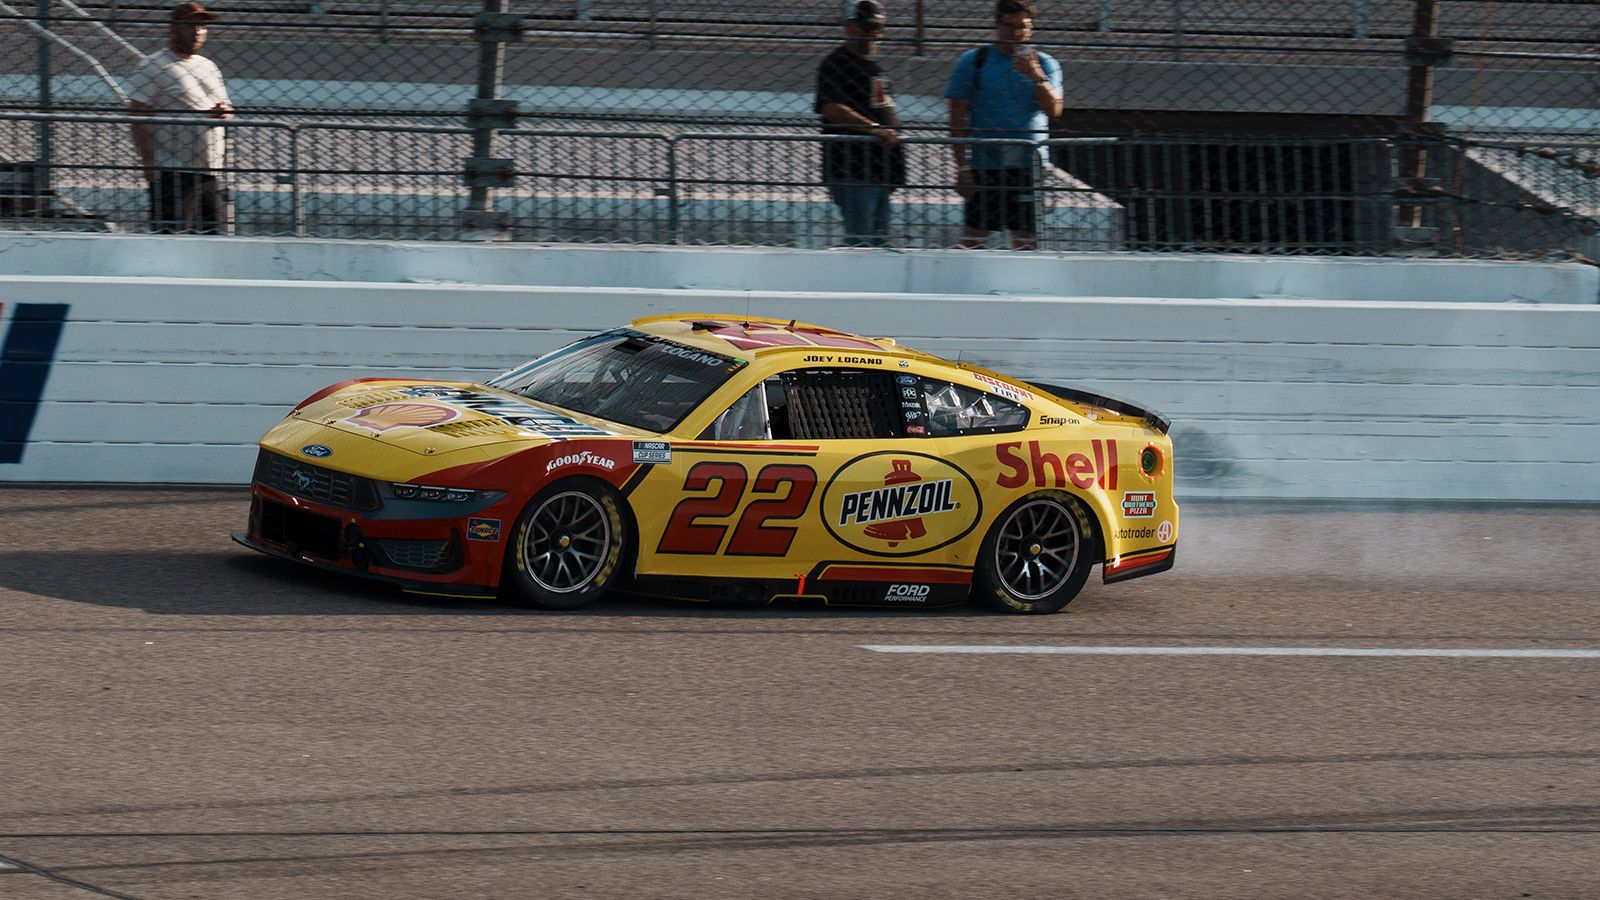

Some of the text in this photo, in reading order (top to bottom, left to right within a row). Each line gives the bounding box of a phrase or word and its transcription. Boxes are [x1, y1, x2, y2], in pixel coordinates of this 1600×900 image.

[660, 344, 724, 367] LOGANO
[803, 355, 883, 365] JOEY LOGANO
[972, 371, 1035, 401] DISCOUNT
[993, 385, 1020, 400] TIRE
[1039, 415, 1080, 426] Snap-on
[644, 442, 665, 450] NASCAR
[649, 451, 666, 459] SERIES
[996, 439, 1118, 490] Shell
[655, 461, 818, 557] 22
[1123, 501, 1155, 509] BROTHERS
[469, 525, 500, 535] SUNOCO
[887, 584, 930, 596] FORD
